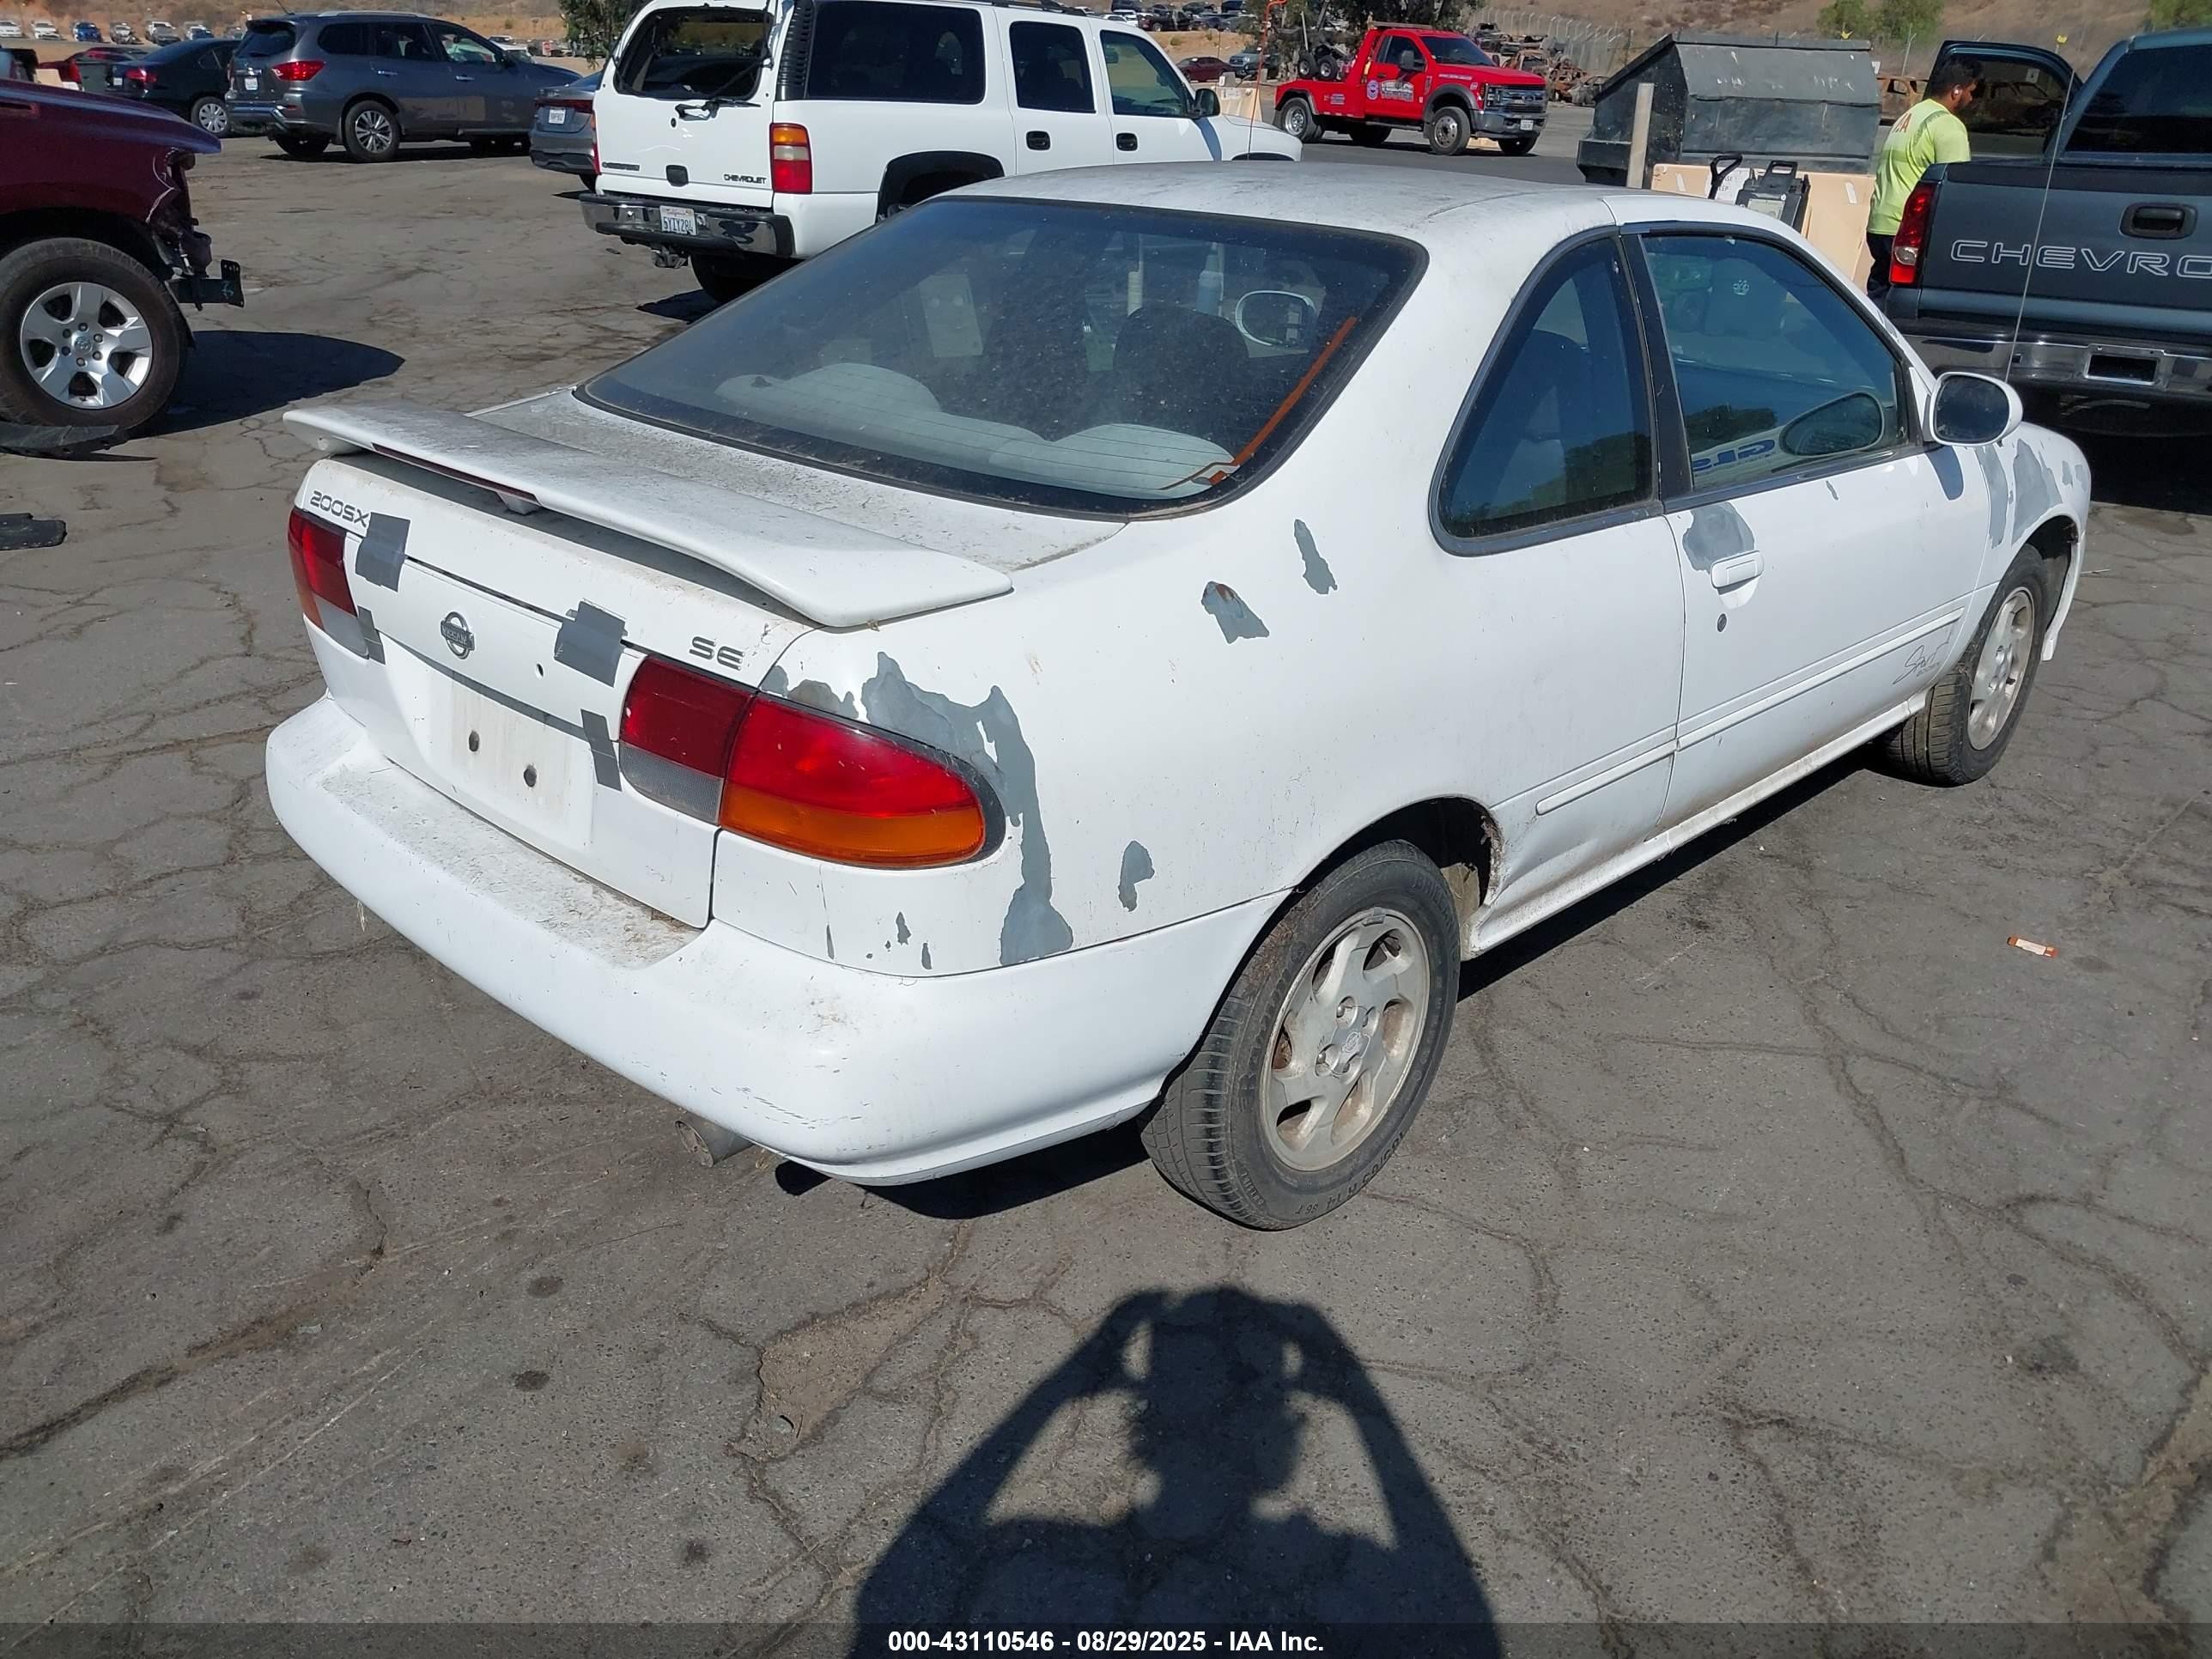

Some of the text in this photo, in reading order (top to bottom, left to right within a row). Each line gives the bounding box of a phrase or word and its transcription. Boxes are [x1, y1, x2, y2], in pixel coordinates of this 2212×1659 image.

[723, 173, 767, 185] CHEVROLET
[1950, 240, 2212, 279] CHEVRO
[309, 489, 369, 528] 200SX
[689, 635, 746, 671] SE
